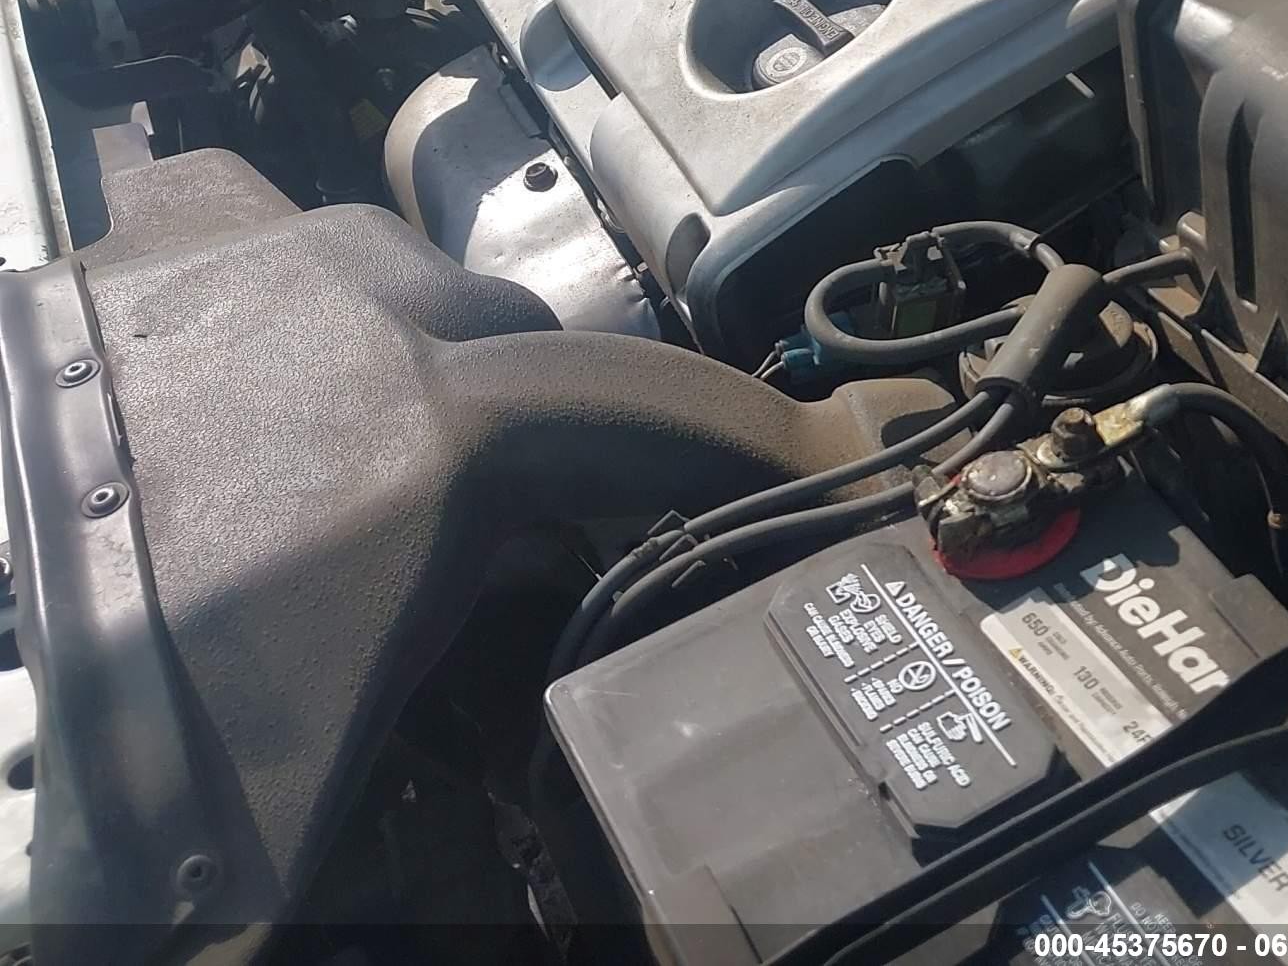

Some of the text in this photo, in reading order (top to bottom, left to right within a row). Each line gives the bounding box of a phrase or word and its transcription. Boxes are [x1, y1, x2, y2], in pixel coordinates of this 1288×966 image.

[827, 614, 854, 643] GASES
[838, 608, 877, 653] EXPLOSIVE
[863, 619, 885, 643] EYES
[873, 614, 903, 642] SHIELD
[1021, 612, 1049, 637] 650
[1079, 551, 1230, 695] DieHar
[886, 679, 904, 693] NO
[1072, 665, 1099, 691] 130
[917, 722, 971, 787] SULFURIC ACID
